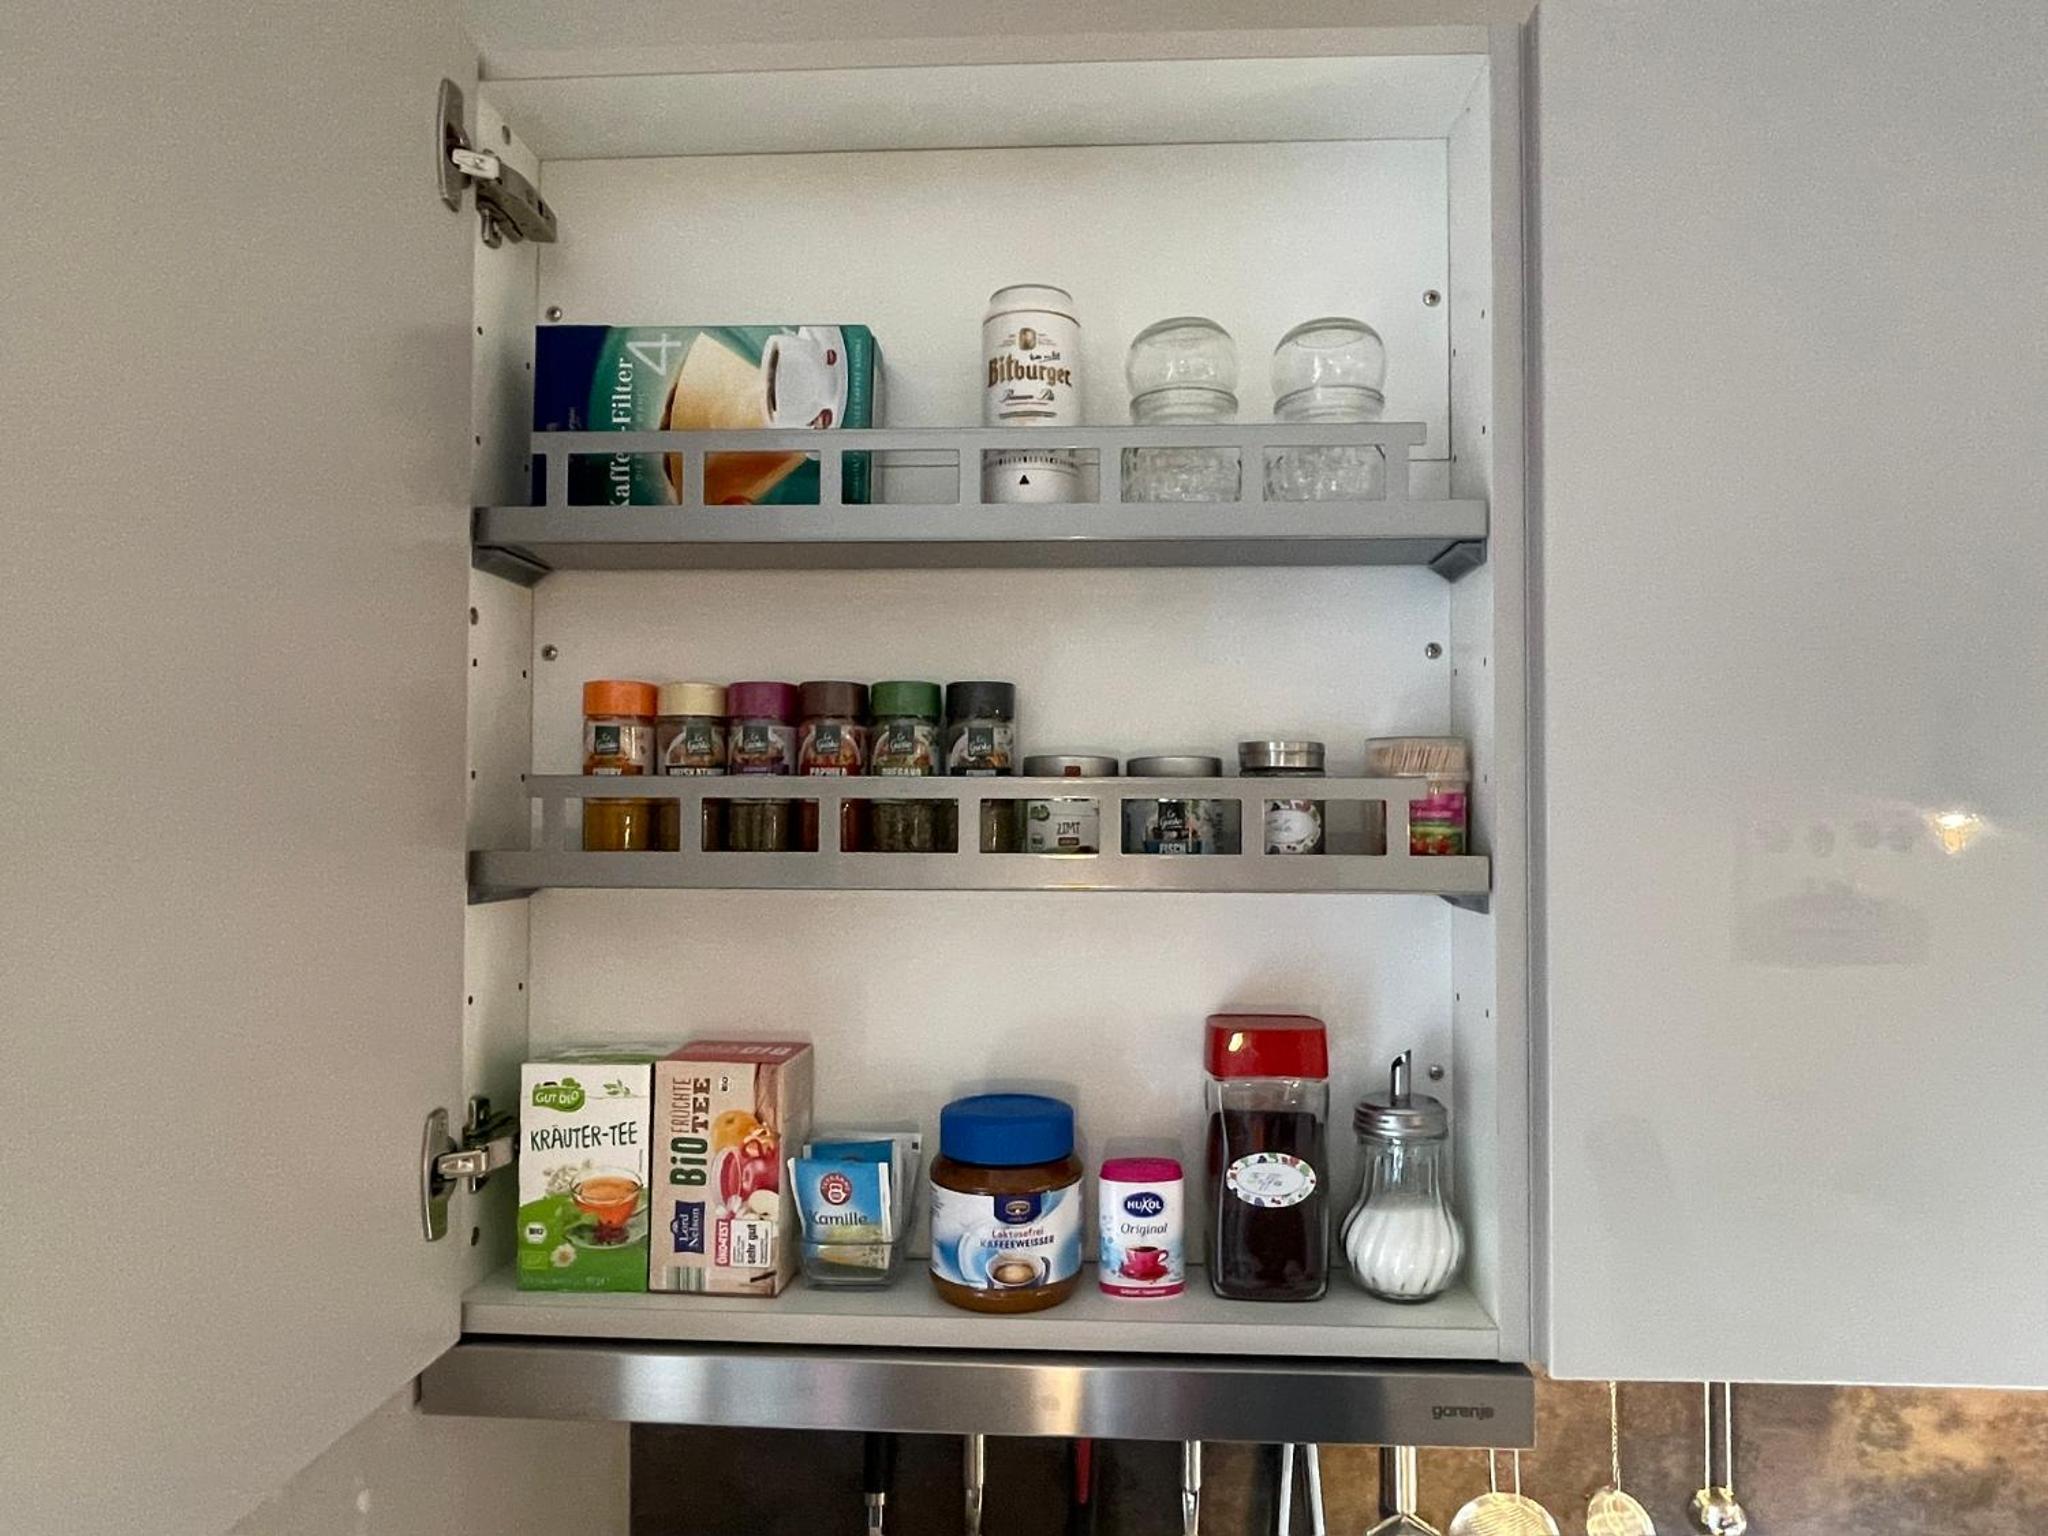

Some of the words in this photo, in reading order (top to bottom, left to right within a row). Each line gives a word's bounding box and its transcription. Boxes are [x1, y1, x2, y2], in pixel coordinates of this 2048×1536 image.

[626, 333, 682, 377] 4
[988, 354, 1072, 388] Bitburger
[1056, 821, 1080, 835] ZIMT
[535, 1092, 557, 1103] GUT
[691, 1077, 711, 1134] TEE
[530, 1121, 638, 1152] KRÄUTER-TEE
[1126, 1197, 1162, 1214] HUXOL
[808, 1210, 868, 1226] Kamille
[679, 1213, 689, 1242] Lord
[689, 1208, 700, 1248] Nelson
[747, 1224, 759, 1240] gut
[992, 1226, 1044, 1239] Laktosefrei
[1120, 1222, 1169, 1237] Original
[979, 1234, 1055, 1250] KAFFEEWEISSER
[747, 1243, 757, 1264] sehr
[1431, 1402, 1495, 1421] gorenje
